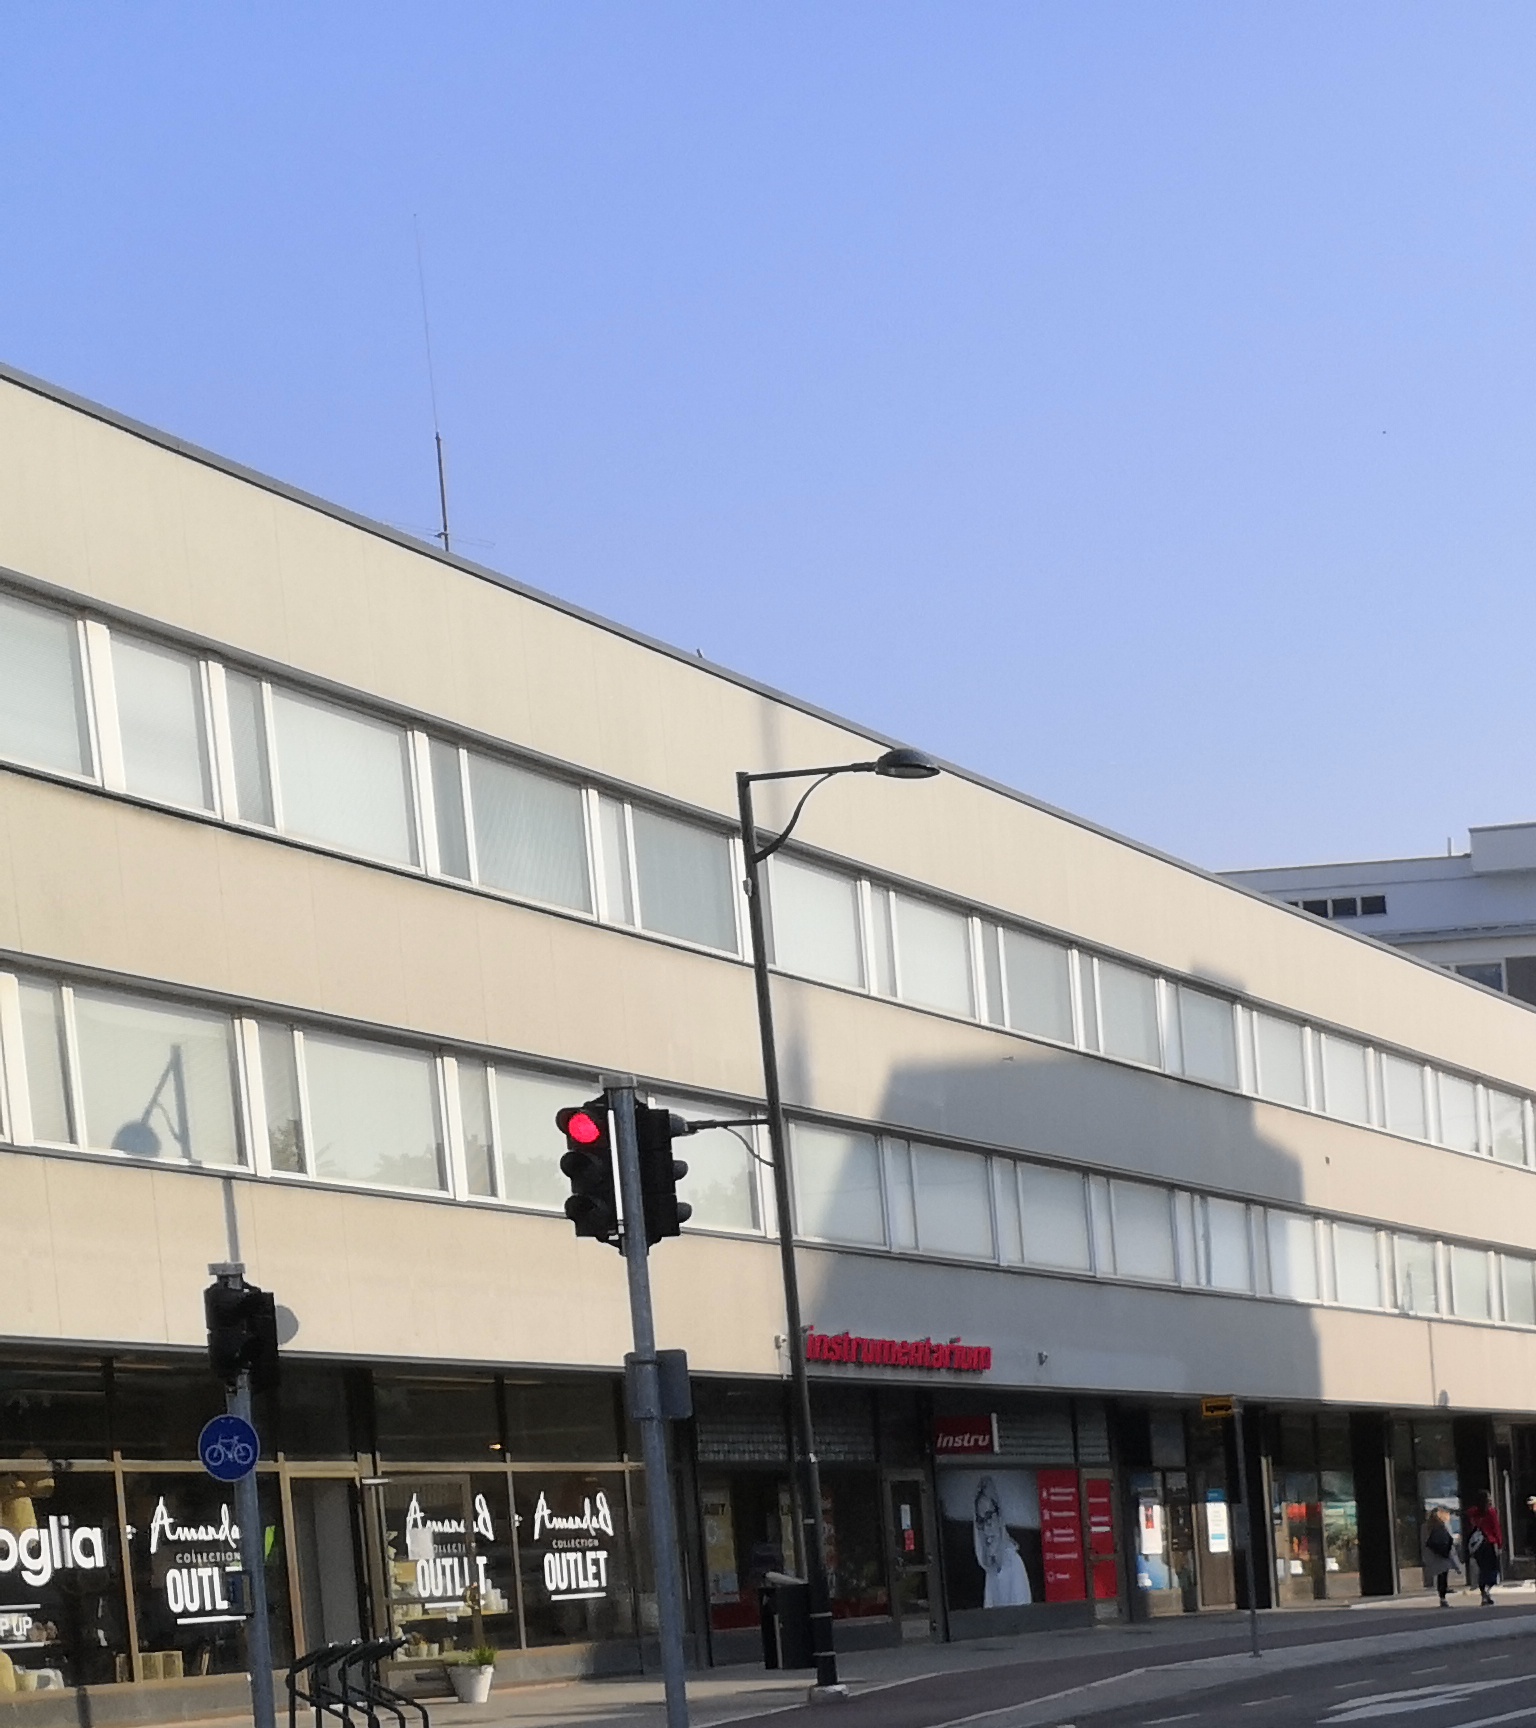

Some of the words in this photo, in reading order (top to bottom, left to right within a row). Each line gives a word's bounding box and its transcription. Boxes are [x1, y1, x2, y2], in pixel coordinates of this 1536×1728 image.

[806, 1325, 993, 1371] instrumentarium
[936, 1432, 990, 1448] instru
[0, 1515, 105, 1586] oglia
[175, 1549, 241, 1564] COLLECTION
[552, 1539, 599, 1549] COLLECTION
[166, 1567, 242, 1613] OUTL
[543, 1550, 608, 1591] OUTLET
